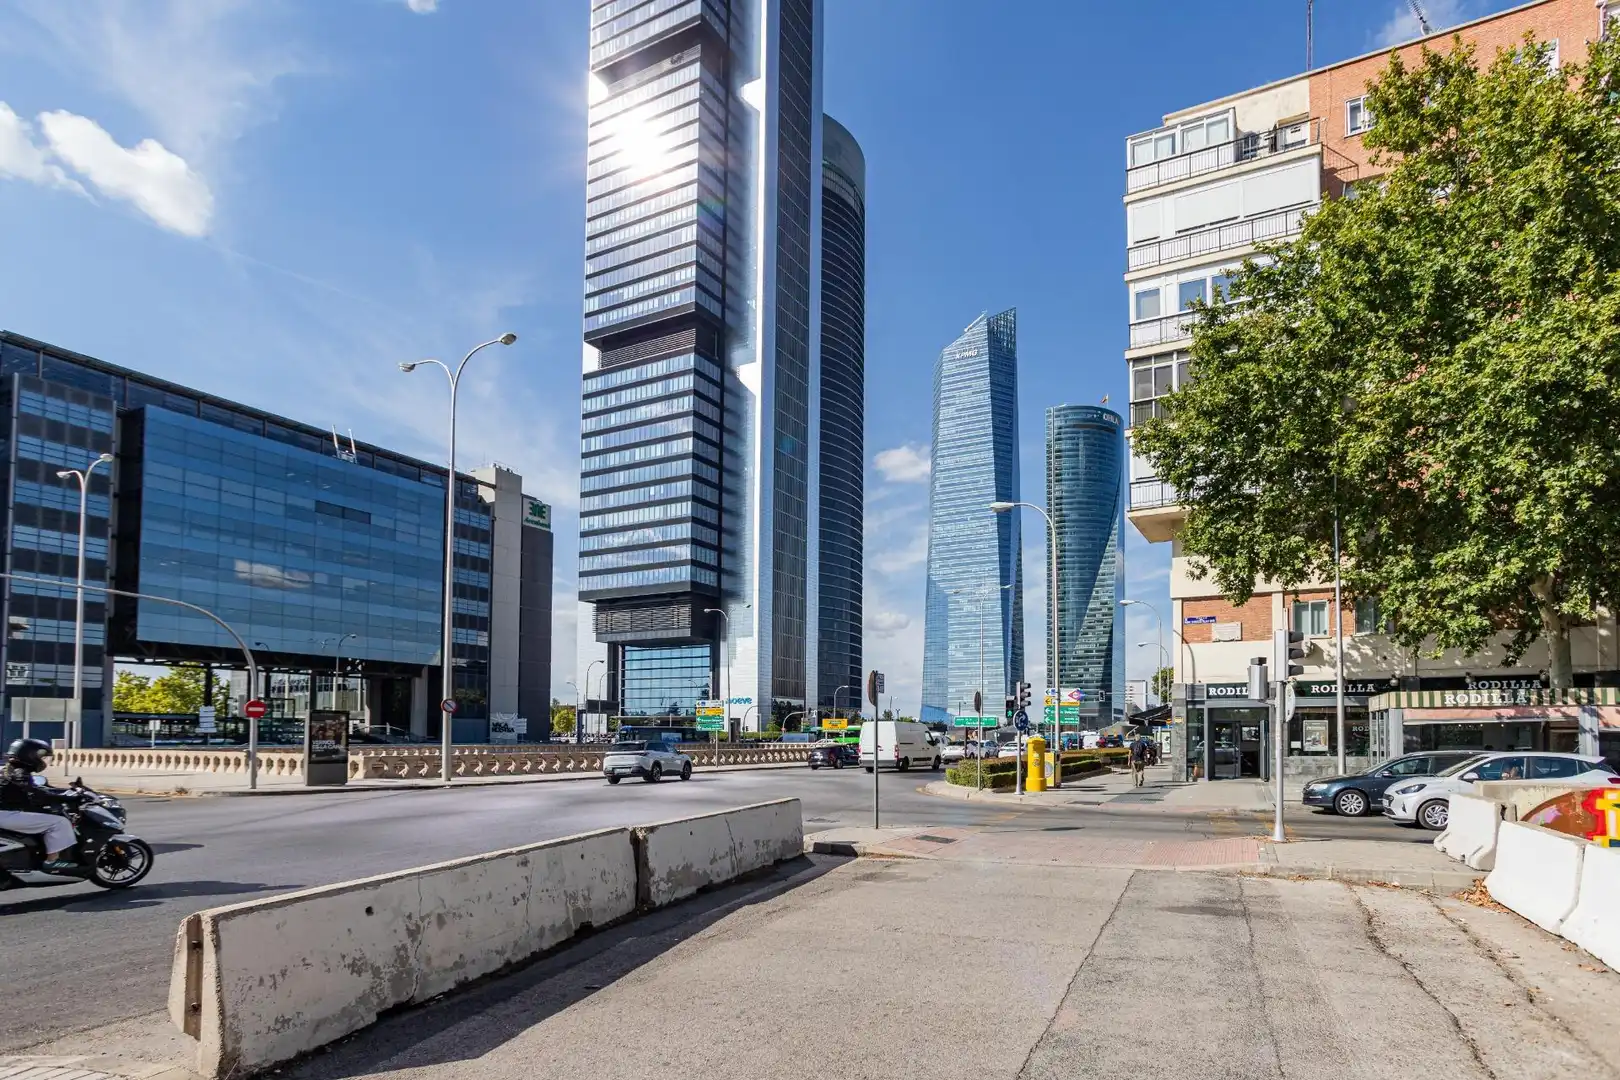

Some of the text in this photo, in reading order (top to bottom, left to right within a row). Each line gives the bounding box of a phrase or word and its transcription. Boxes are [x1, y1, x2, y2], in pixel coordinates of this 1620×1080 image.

[956, 349, 978, 358] KPMG
[1468, 680, 1542, 690] RODILLA
[1208, 686, 1249, 696] RODIL
[1444, 688, 1528, 705] RODILLA
